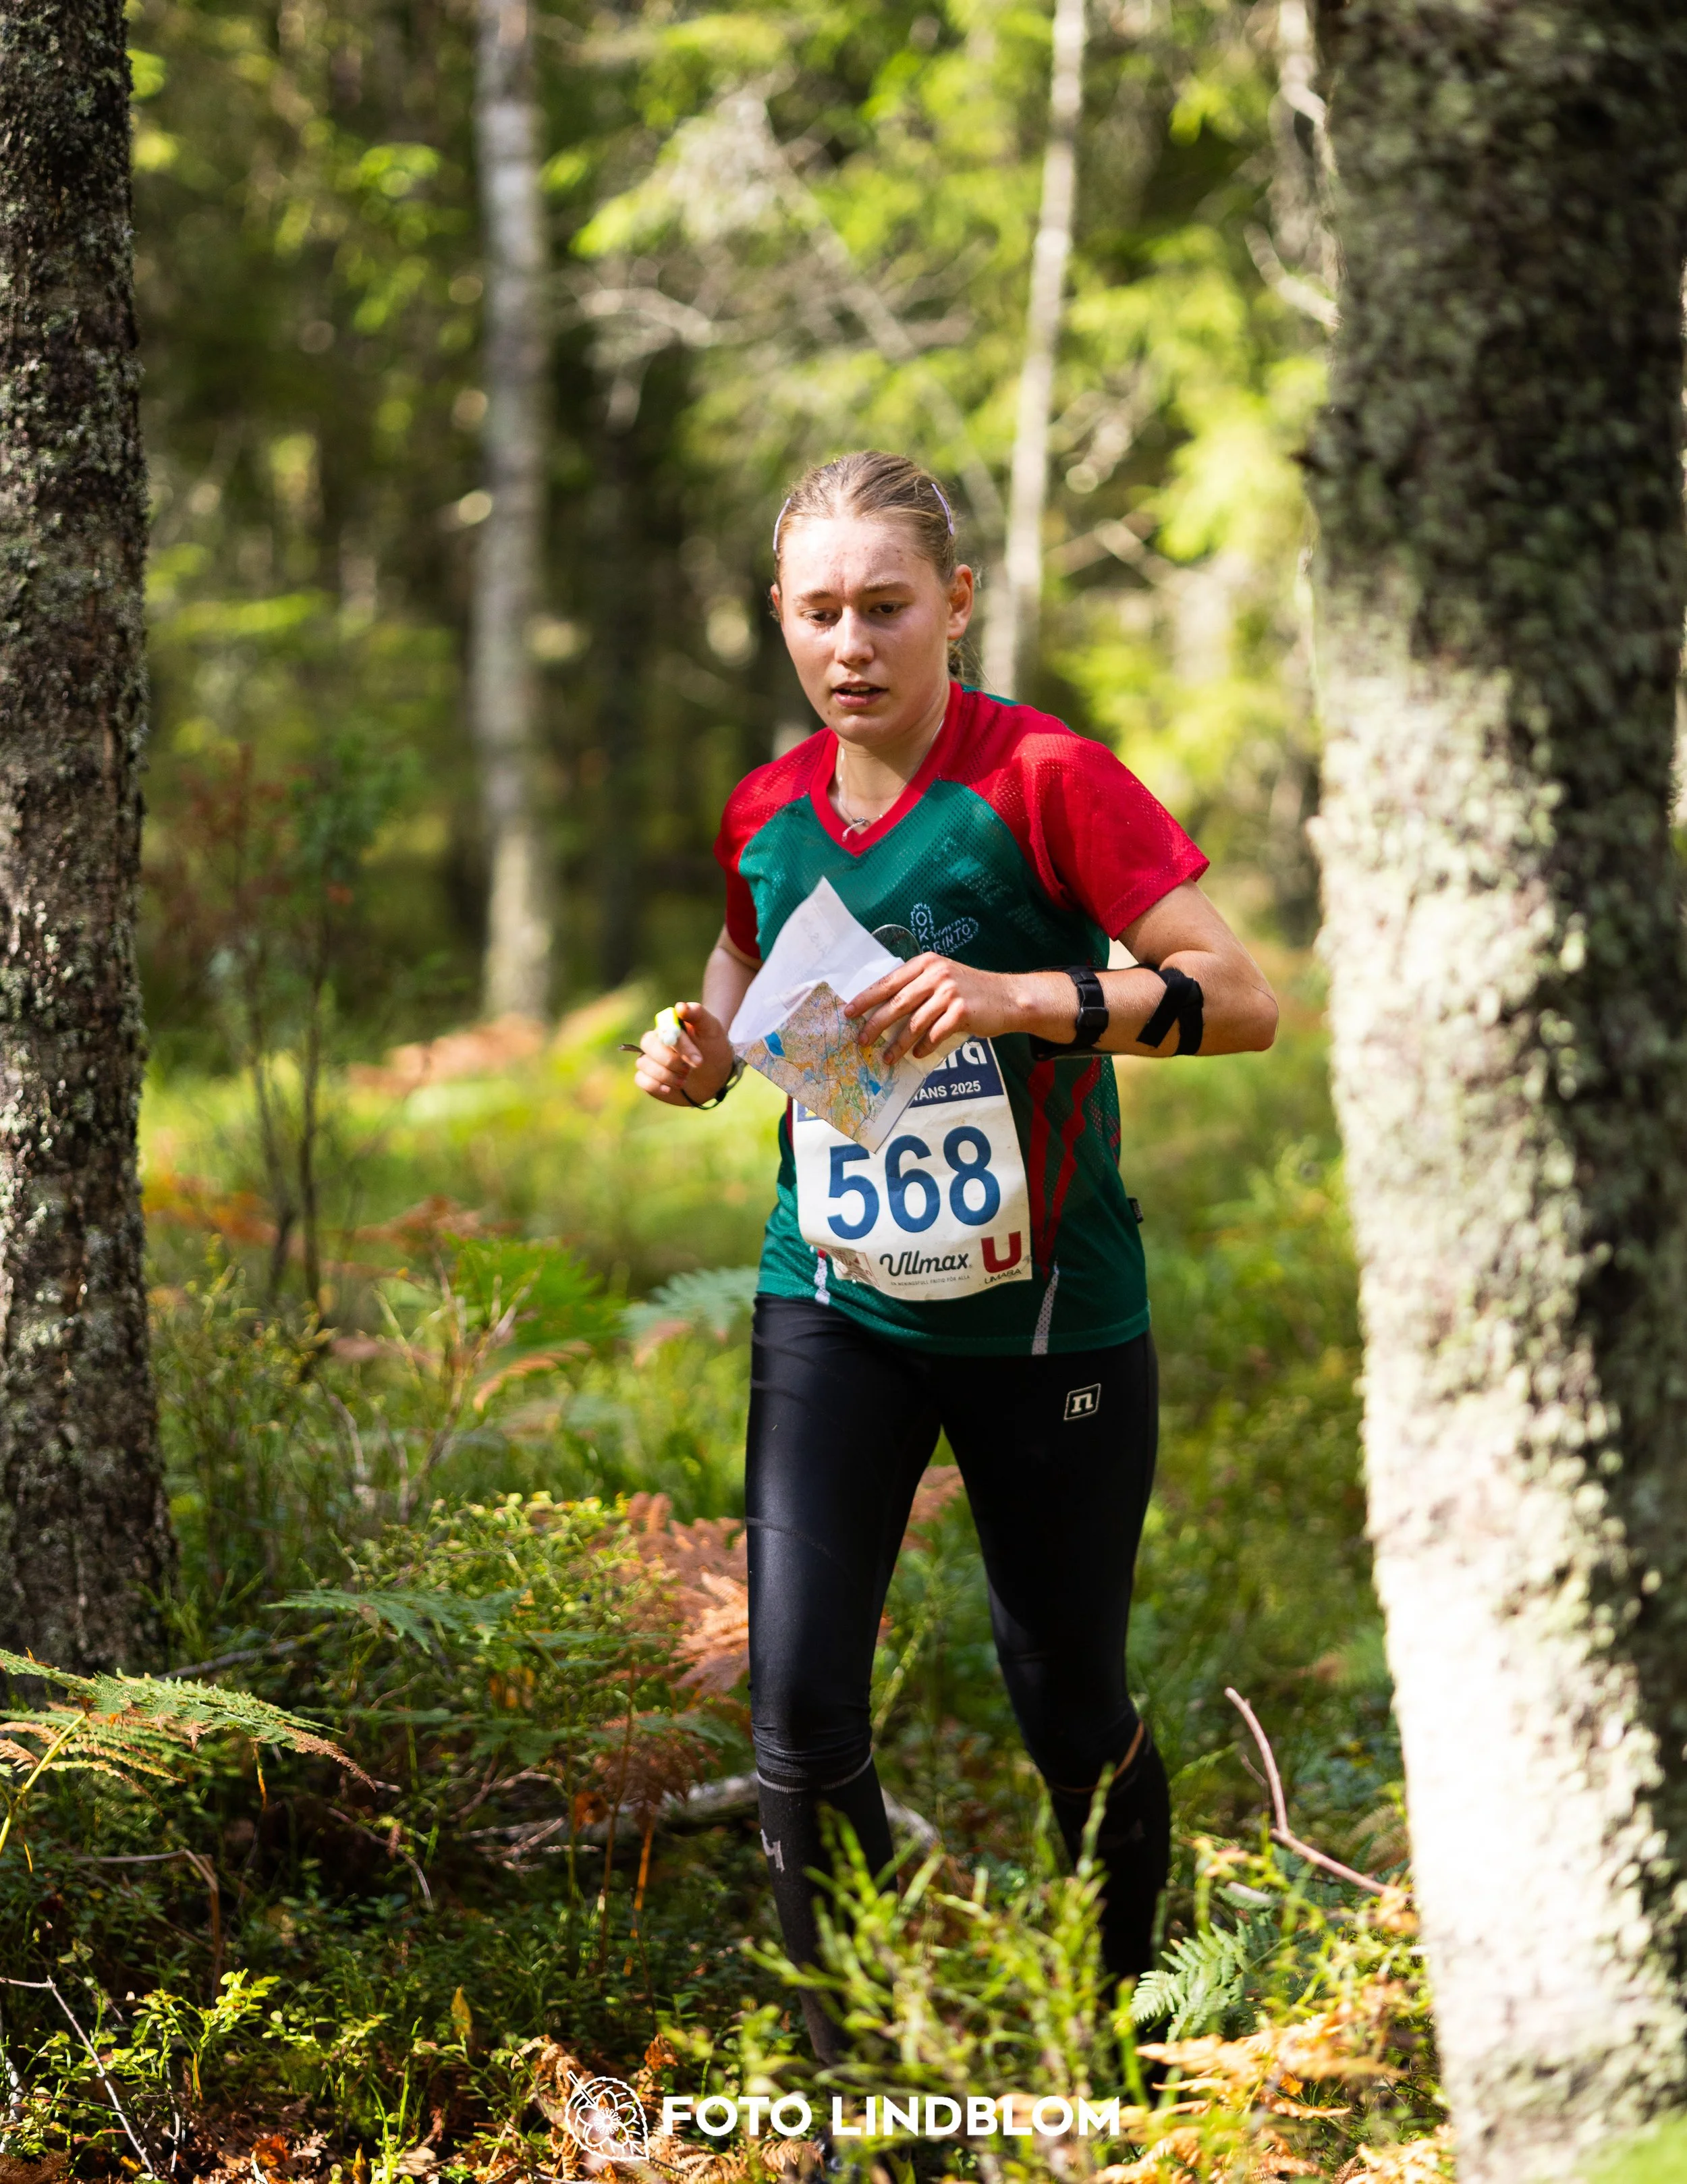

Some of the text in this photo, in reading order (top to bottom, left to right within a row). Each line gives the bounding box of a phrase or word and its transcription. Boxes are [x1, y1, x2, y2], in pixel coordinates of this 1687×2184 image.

[950, 1081, 981, 1095] 2025
[827, 1125, 1001, 1240] 568
[879, 1250, 969, 1277] Ullmax
[985, 1268, 1022, 1284] UMARA
